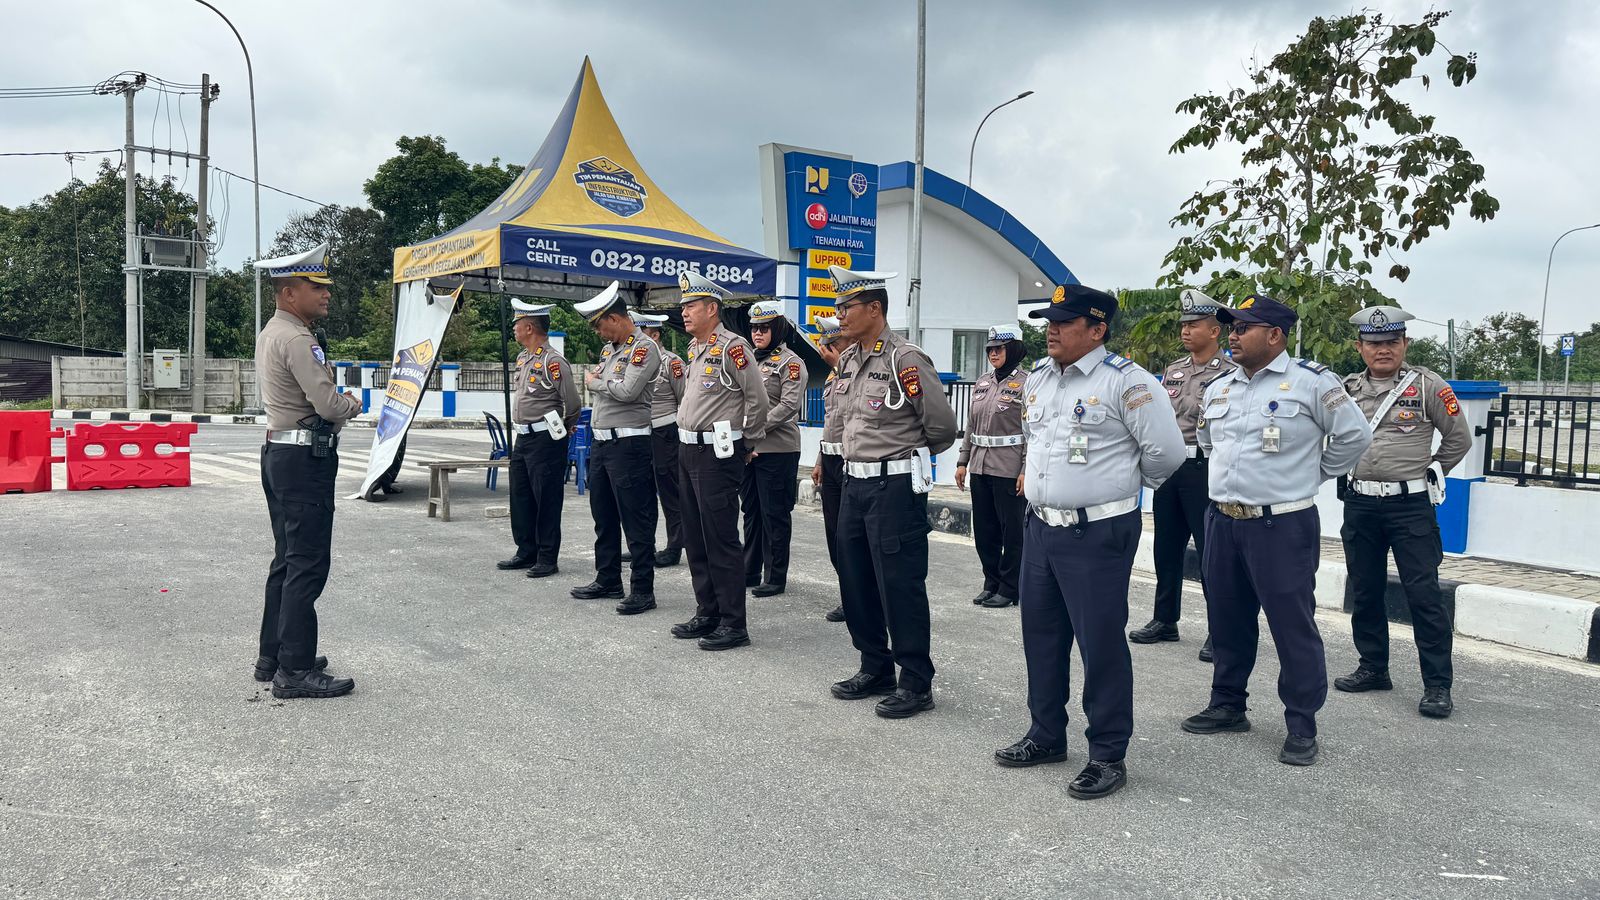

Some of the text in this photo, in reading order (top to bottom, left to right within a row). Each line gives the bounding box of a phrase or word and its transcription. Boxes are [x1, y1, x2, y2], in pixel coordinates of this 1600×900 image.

[592, 174, 641, 191] PEMANTAUAN
[588, 182, 639, 198] INFRASTRUKTUR
[809, 211, 826, 222] adhi
[829, 213, 876, 227] JALINTIM RIAU
[815, 235, 864, 249] TENAYAN RAYA
[526, 251, 578, 267] CENTER
[526, 237, 754, 285] CALL 0822 8885 8884
[815, 254, 847, 266] UPPKB
[811, 283, 836, 293] MUSHO
[704, 356, 721, 365] POLRI
[867, 372, 890, 382] POLRI
[899, 366, 917, 377] POLDA
[903, 375, 918, 383] RIAU
[1393, 399, 1421, 408] POLRI
